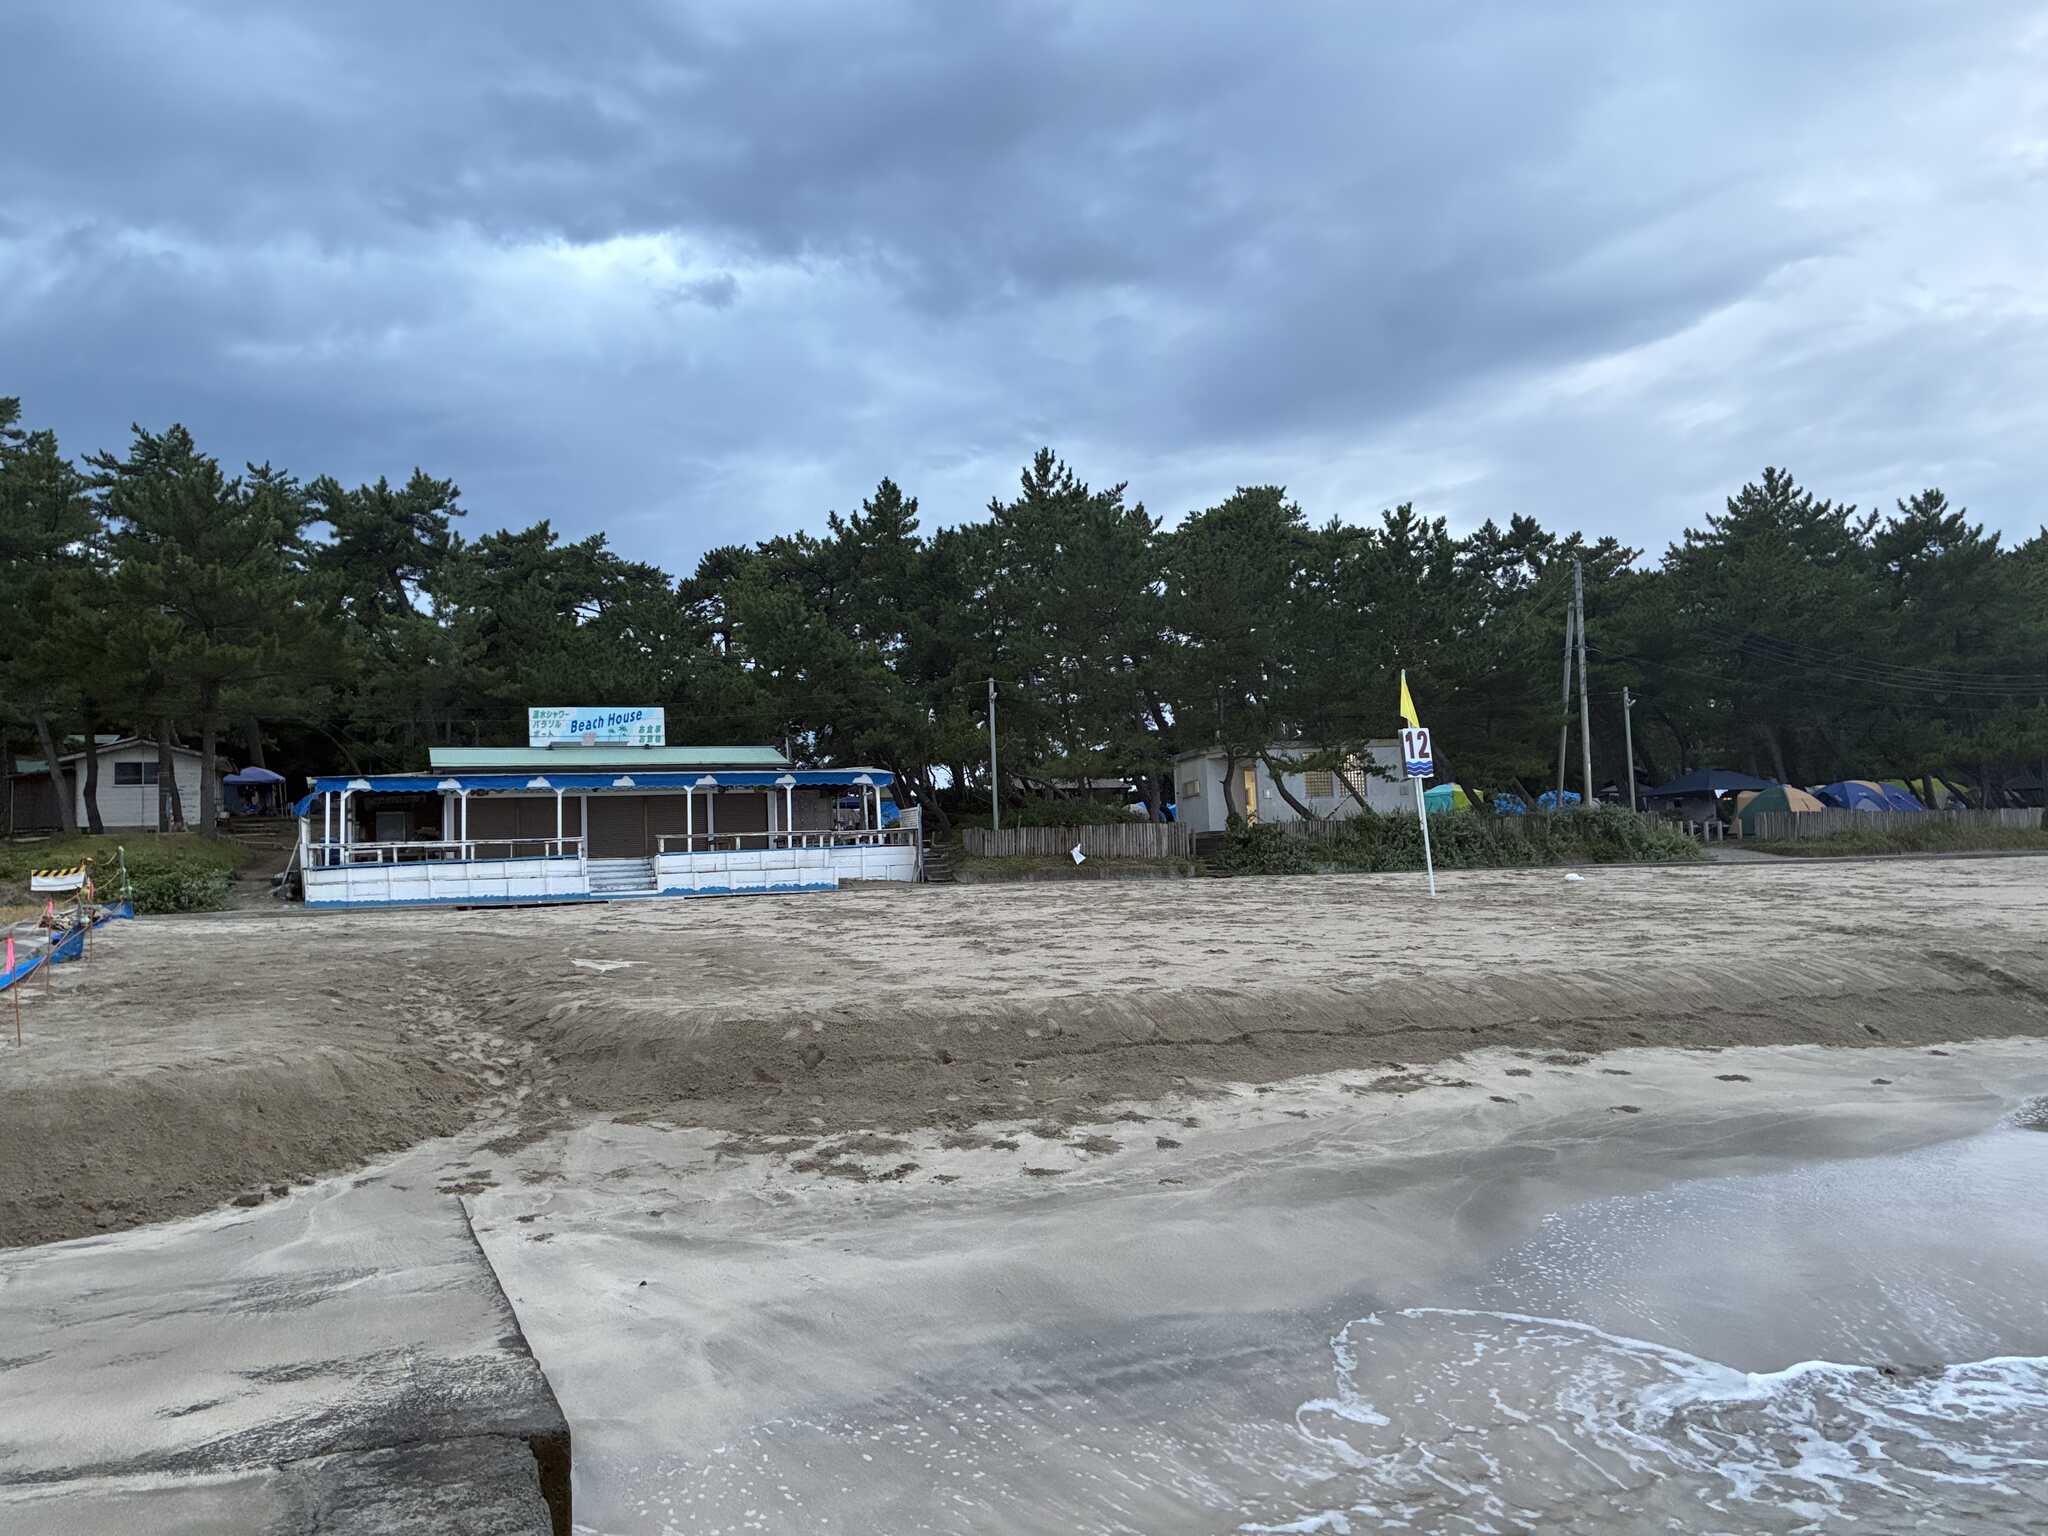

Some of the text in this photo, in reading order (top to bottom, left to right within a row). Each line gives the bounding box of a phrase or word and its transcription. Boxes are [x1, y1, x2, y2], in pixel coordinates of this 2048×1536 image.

[570, 710, 642, 733] Beach House
[1405, 731, 1430, 759] 12
